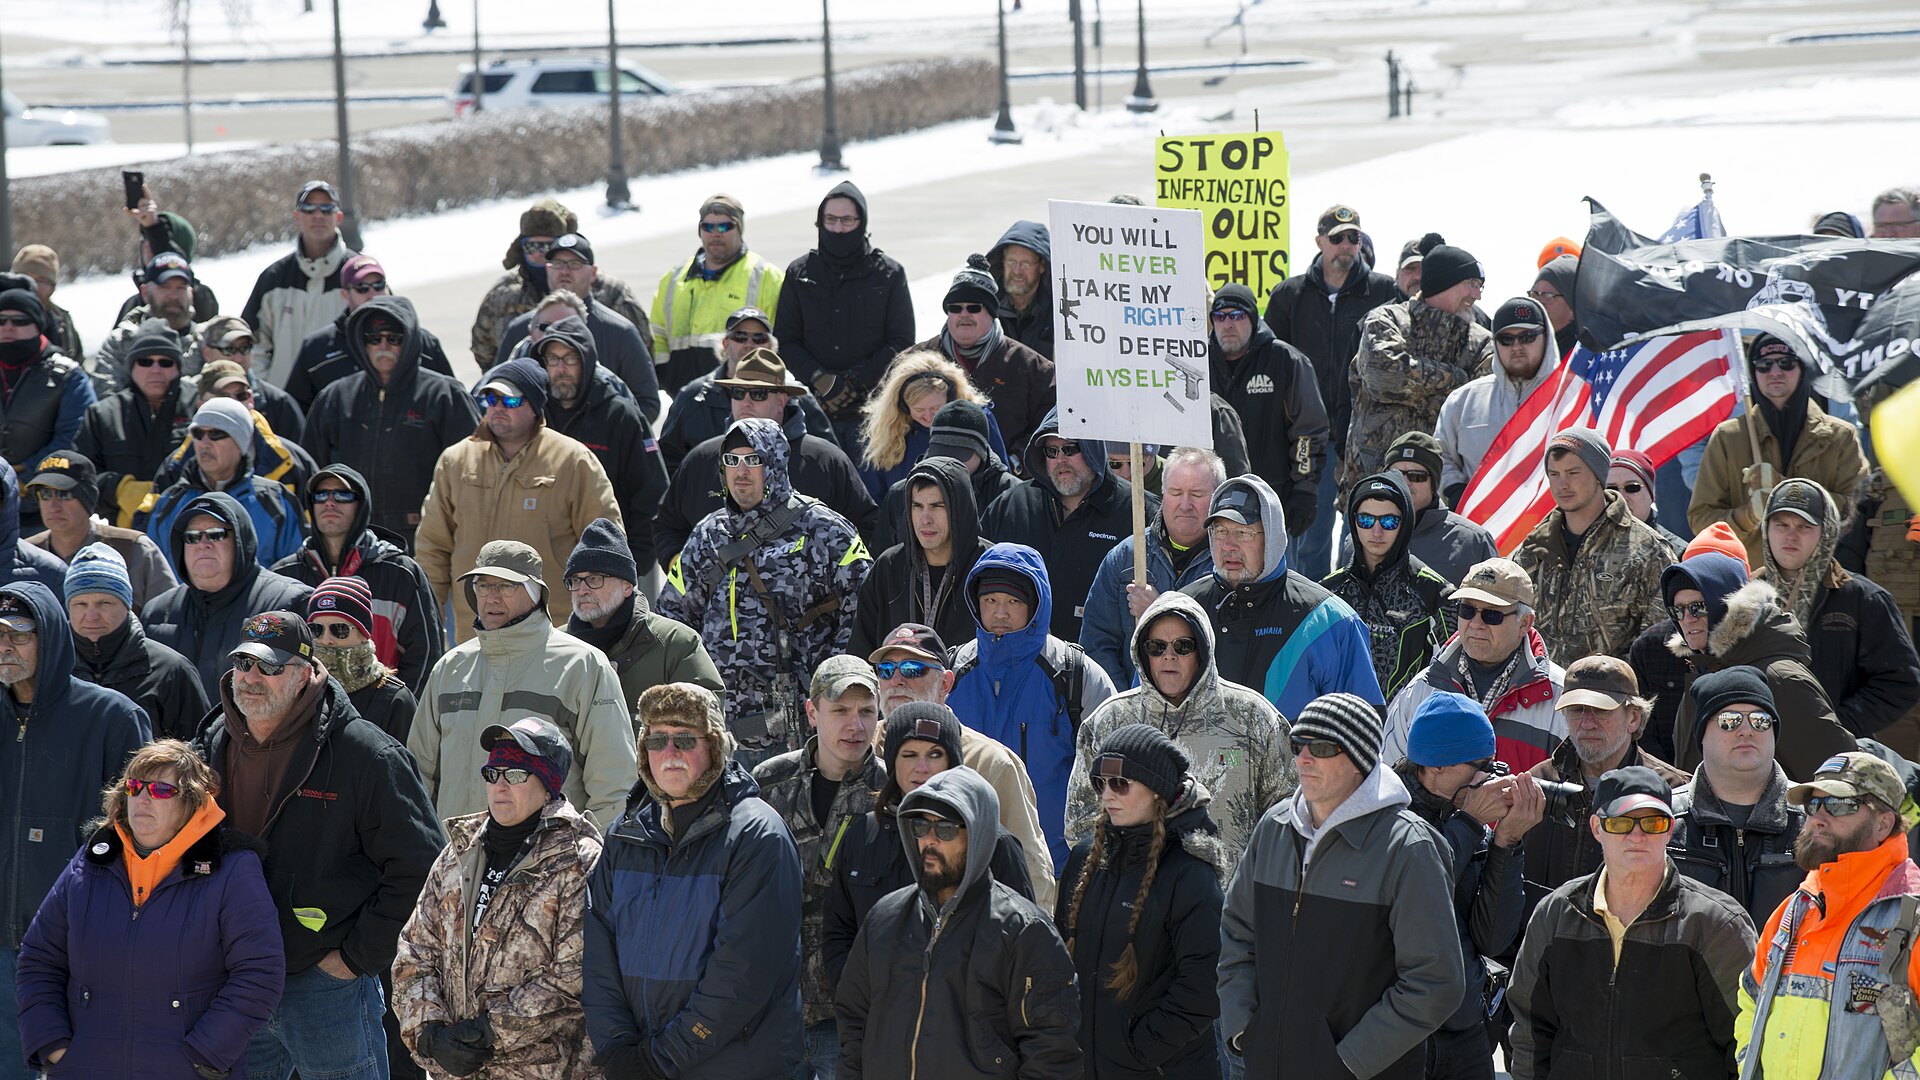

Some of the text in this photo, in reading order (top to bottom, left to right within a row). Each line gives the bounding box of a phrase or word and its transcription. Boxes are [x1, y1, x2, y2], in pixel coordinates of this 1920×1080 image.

[1159, 137, 1273, 172] STOP
[1158, 178, 1286, 207] INFRINGING
[1212, 208, 1281, 240] OUR
[1073, 223, 1177, 249] YOU WILL
[1100, 252, 1177, 275] NEVER
[1205, 250, 1287, 298] GHTS
[1073, 279, 1171, 304] TAKE MY
[1124, 306, 1184, 326] RIGHT
[1079, 324, 1106, 344] TO
[1120, 336, 1207, 358] DEFEND
[1086, 368, 1176, 388] MYSELF
[1247, 374, 1274, 389] MAC
[1089, 531, 1118, 541] Spectrum
